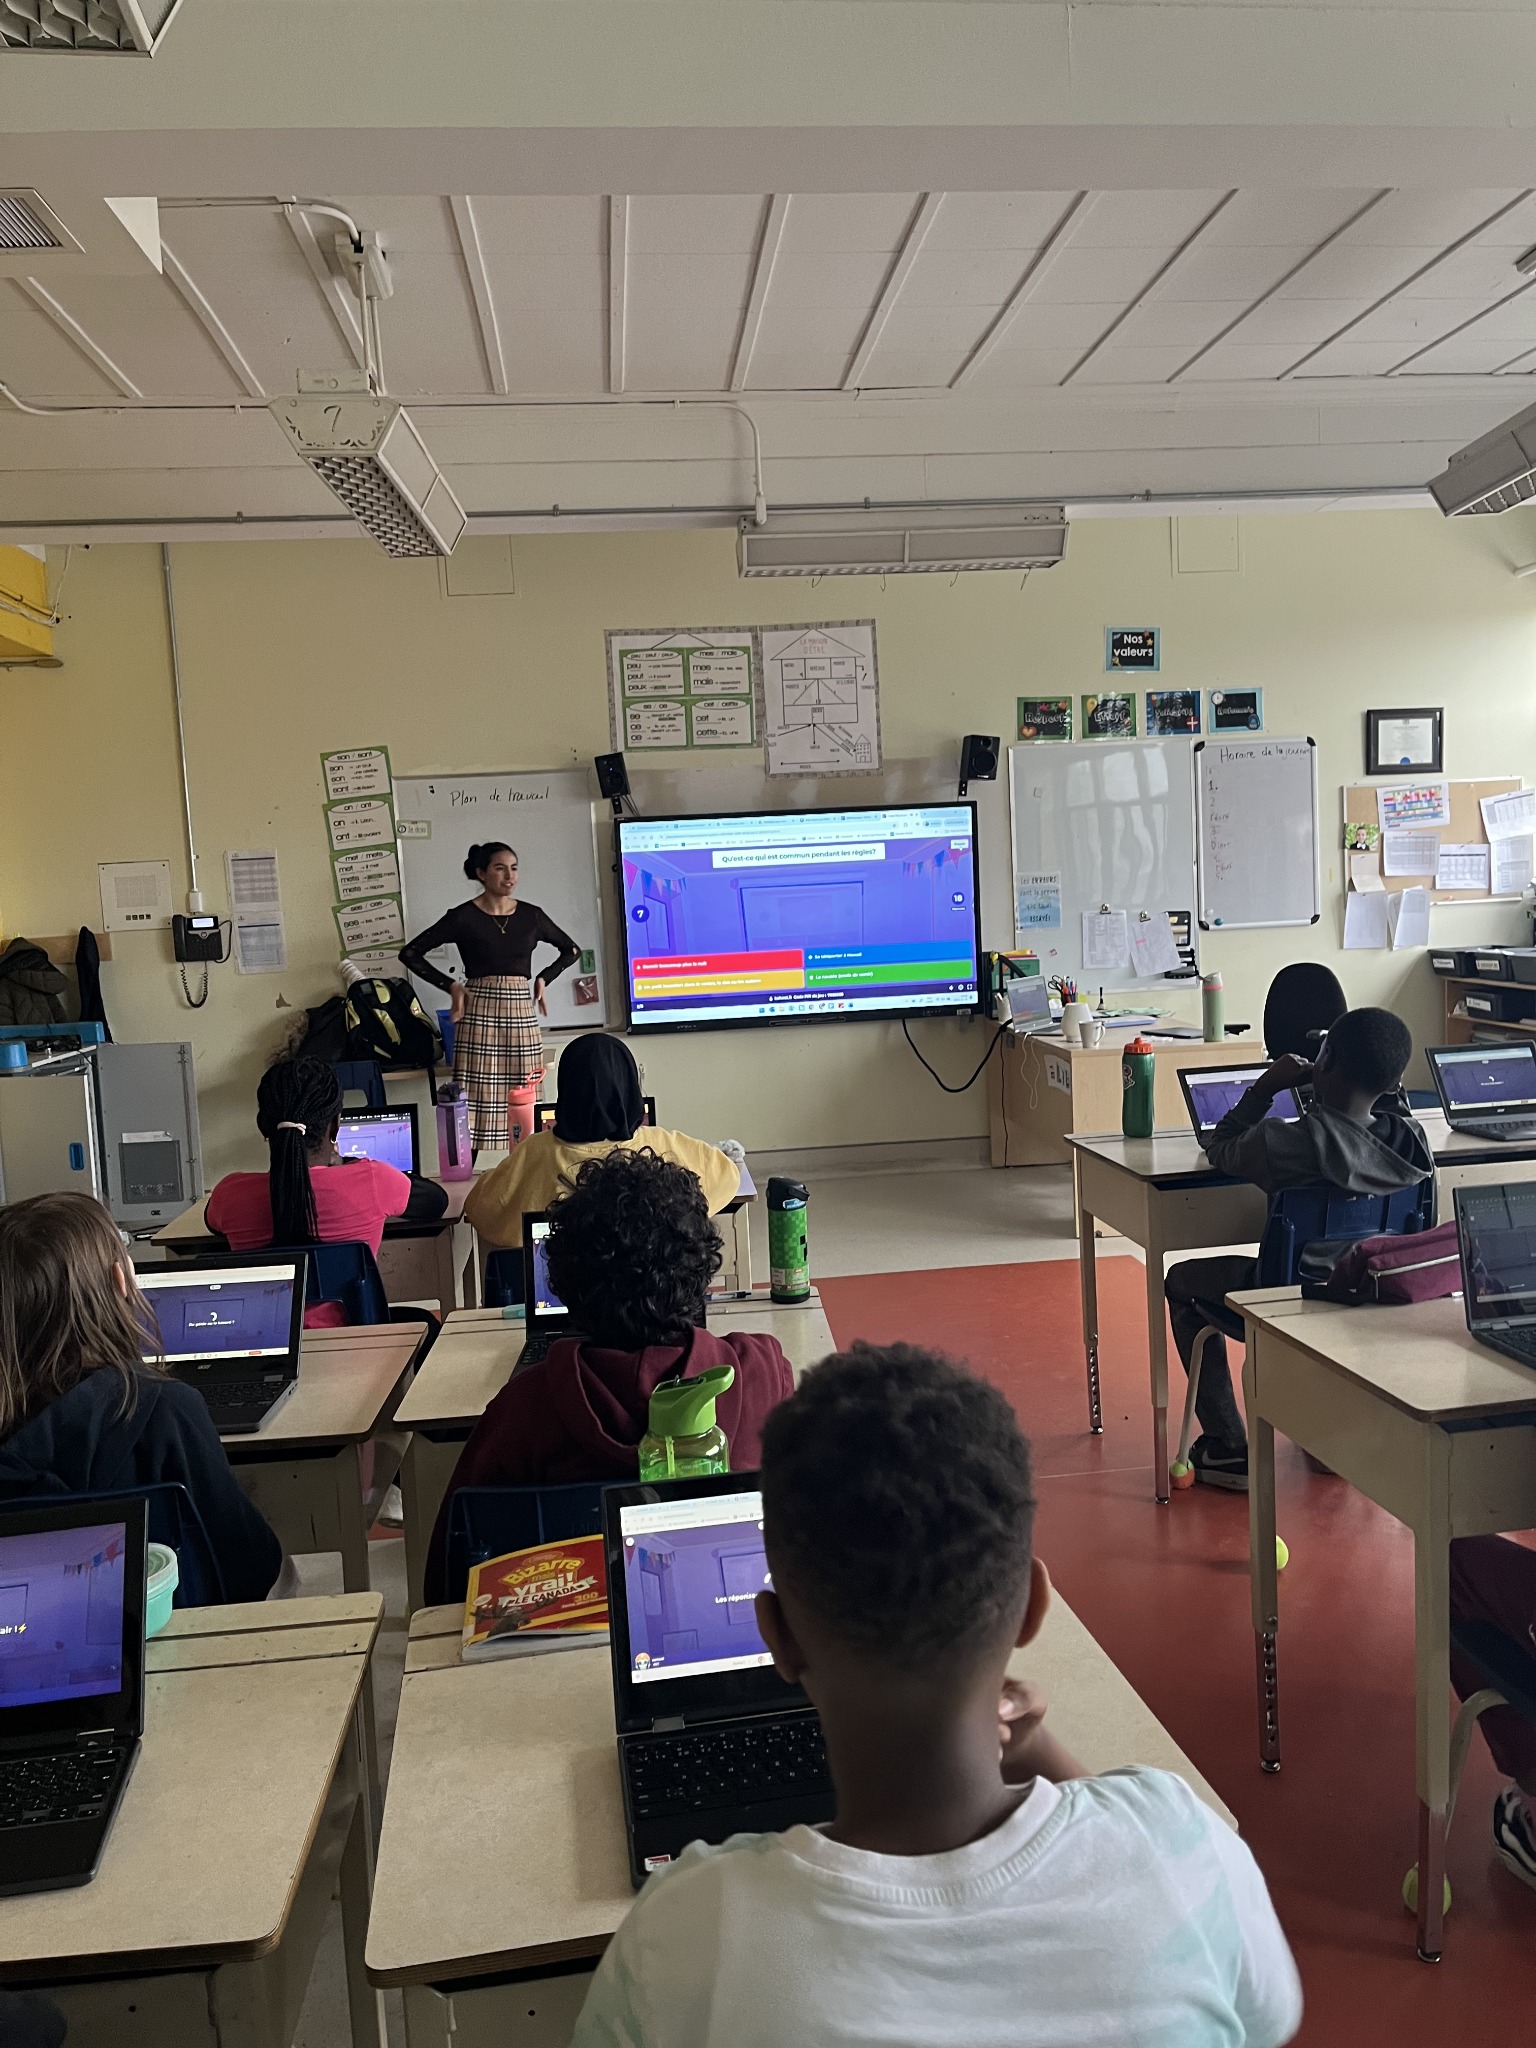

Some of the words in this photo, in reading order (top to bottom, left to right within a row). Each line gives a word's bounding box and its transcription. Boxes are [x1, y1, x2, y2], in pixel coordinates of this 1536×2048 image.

[1124, 634, 1142, 644] Nos
[1114, 647, 1152, 656] valeurs
[1220, 746, 1255, 763] Horaire
[1262, 746, 1271, 756] de
[450, 790, 477, 806] Plan
[490, 788, 500, 802] de
[509, 786, 549, 802] travail
[336, 833, 350, 841] ont
[341, 875, 360, 883] mets
[342, 885, 361, 893] mets
[637, 910, 644, 918] 7
[502, 1559, 581, 1584] Bizarre
[514, 1572, 574, 1596] vrai!
[532, 1586, 576, 1602] CANADA
[715, 1596, 728, 1604] Les
